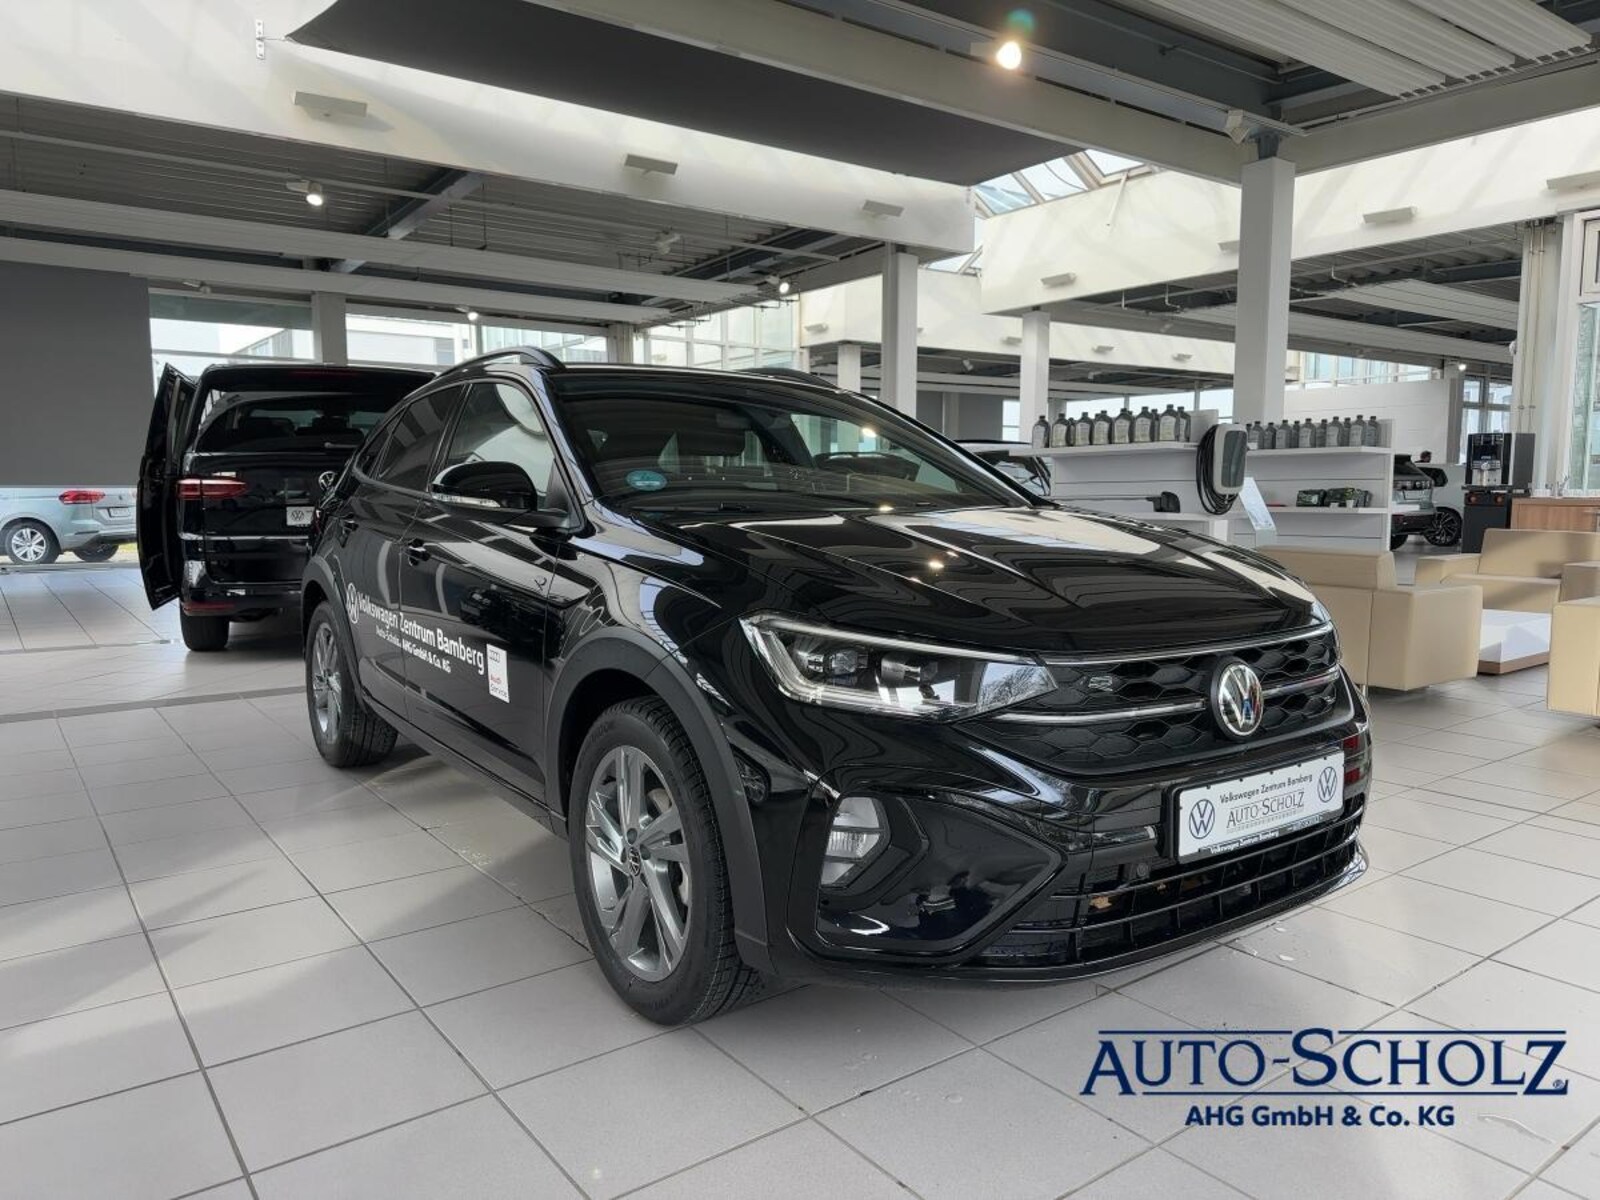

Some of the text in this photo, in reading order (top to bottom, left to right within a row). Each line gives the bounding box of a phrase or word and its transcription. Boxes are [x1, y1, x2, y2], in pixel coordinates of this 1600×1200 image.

[357, 591, 485, 676] Volkswagen Zentrum Bamberg
[1219, 774, 1313, 803] Volkswagen Zentrum Bamberg
